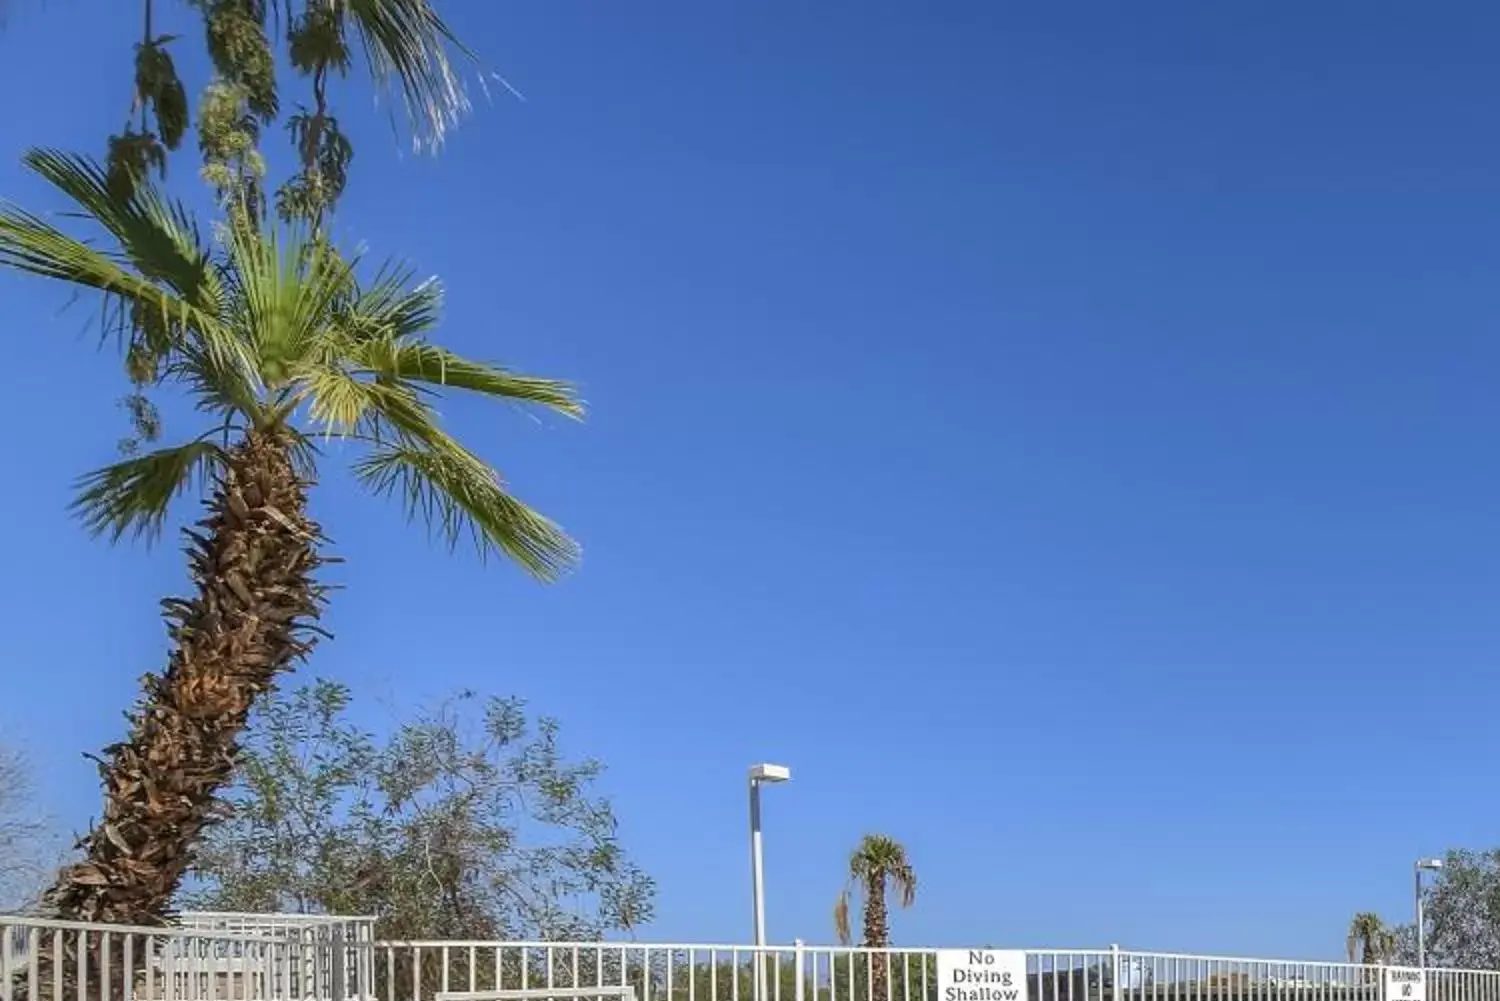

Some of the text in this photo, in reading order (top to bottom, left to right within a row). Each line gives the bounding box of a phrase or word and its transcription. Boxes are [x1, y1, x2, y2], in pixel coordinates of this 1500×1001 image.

[969, 951, 995, 965] No
[953, 968, 1013, 986] Diving
[945, 987, 1019, 1001] Shallow
